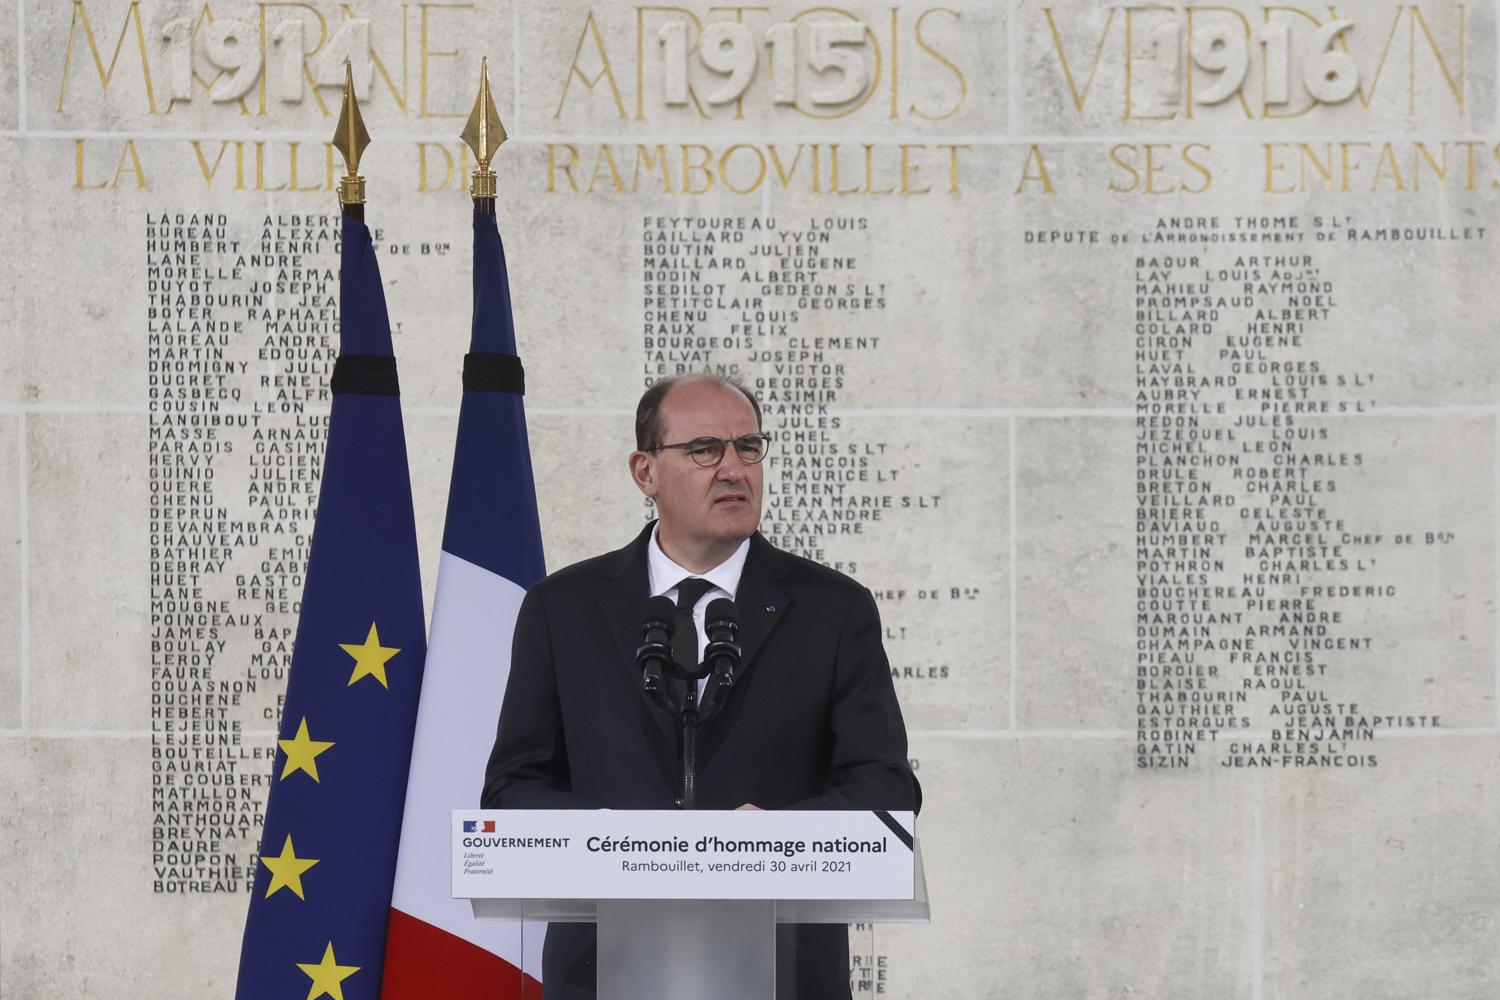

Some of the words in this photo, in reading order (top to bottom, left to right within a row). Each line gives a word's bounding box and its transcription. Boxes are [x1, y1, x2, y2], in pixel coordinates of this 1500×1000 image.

[161, 17, 376, 104] 1914
[656, 19, 871, 105] 1915
[1152, 19, 1360, 105] 1916
[73, 139, 148, 191] LA
[1014, 144, 1057, 195] A
[1106, 144, 1213, 195] SES
[644, 218, 775, 229] FEYTOUREAU
[811, 218, 867, 230] LOUIS
[1157, 218, 1219, 228] ANDRE
[1235, 217, 1299, 228] THOME
[147, 227, 225, 239] BUREAU
[643, 232, 743, 242] GAILLARD
[779, 232, 829, 242] YVON
[1025, 231, 1098, 243] DEPUTE
[1111, 234, 1129, 244] DE
[1316, 232, 1335, 241] DE
[1348, 229, 1486, 240] RAMBOUILLET
[147, 241, 240, 252] HUMBERT
[261, 242, 319, 253] HENRI
[644, 245, 713, 255] BOUTIN
[749, 246, 818, 256] JULIEN
[147, 254, 200, 265] LANE
[236, 255, 302, 267] ANDRE
[644, 258, 745, 269] MAILLARD
[780, 258, 856, 269] EUGENE
[148, 267, 242, 279] MORELLE
[644, 271, 700, 281] BODIN
[740, 272, 818, 282] ALBERT
[644, 285, 726, 295] SEDILOT
[761, 285, 836, 295] GEDEON
[148, 294, 263, 306] THABOURIN
[644, 298, 762, 308] PETITCLAIR
[798, 298, 886, 309] GEORGES
[1288, 296, 1336, 307] NOEL
[148, 307, 213, 319] BOYER
[645, 311, 707, 321] CHENU
[742, 311, 798, 322] LOUIS
[148, 321, 243, 332] LALANDE
[644, 324, 695, 334] RAUX
[731, 325, 787, 336] FELIX
[149, 334, 228, 346] MOREAU
[264, 336, 330, 347] ANDRE
[644, 337, 752, 348] BOURGEOIS
[789, 338, 879, 349] CLEMENT
[149, 348, 223, 359] MARTIN
[645, 351, 712, 361] TALVAT
[748, 351, 823, 362] JOSEPH
[774, 365, 844, 375] VICTOR
[149, 374, 226, 386] DUCRET
[261, 376, 310, 387] RENE
[756, 378, 843, 388] GEORGES
[1136, 390, 1200, 400] AUBRY
[1235, 388, 1309, 399] ERNEST
[149, 401, 219, 412] COUSIN
[254, 402, 304, 413] LEON
[778, 417, 840, 428] JULES
[1136, 416, 1198, 427] REDON
[1234, 416, 1294, 427] JULES
[150, 428, 216, 439] MASSE
[149, 441, 232, 453] PARADIS
[781, 444, 838, 455] LOUIS
[150, 454, 213, 466] HERVY
[250, 455, 320, 466] LUCIEN
[770, 457, 868, 467] FRANCOIS
[1137, 456, 1239, 466] PLANCHON
[1274, 454, 1362, 465] CHARLES
[250, 468, 321, 480] JULIEN
[781, 470, 868, 481] MAURICE
[150, 481, 212, 493] QUERE
[248, 482, 314, 493] ANDRE
[1137, 482, 1211, 493] BRETON
[1247, 481, 1336, 492] CHARLES
[150, 495, 213, 506] CHENU
[249, 495, 296, 506] PAUL
[150, 508, 227, 519] DEPRUN
[764, 510, 881, 521] ALEXANDRE
[150, 534, 258, 546] CHAUVEAU
[150, 561, 225, 573] DEBRAY
[151, 574, 200, 586] HUET
[150, 588, 202, 599] LANE
[238, 588, 287, 599] RENE
[152, 627, 218, 639] JAMES
[1137, 627, 1210, 637] DUMAIN
[1246, 625, 1326, 636] ARMAND
[151, 641, 226, 652] BOULAY
[1137, 639, 1254, 650] CHAMPAGNE
[1289, 638, 1372, 649] VINCENT
[152, 654, 215, 666] LEROY
[1230, 652, 1313, 663] FRANCIS
[152, 667, 211, 679] FAURE
[152, 694, 241, 705] DUCHENE
[152, 707, 228, 719] HEBERT
[1137, 730, 1218, 741] ROBINET
[1272, 730, 1373, 740] BENJAMIN
[1137, 756, 1188, 768] SIZIN
[1221, 756, 1377, 767] JEAN-FRANCOIS
[153, 787, 251, 800] MATILLON
[463, 837, 570, 848] GOUVERNEMENT
[586, 837, 689, 853] Cérémonie
[811, 836, 887, 853] national
[622, 860, 705, 875] Rambouillet,
[707, 860, 765, 873] vendredi
[770, 861, 787, 873] 30
[790, 860, 818, 873] avril
[821, 861, 852, 873] 2021
